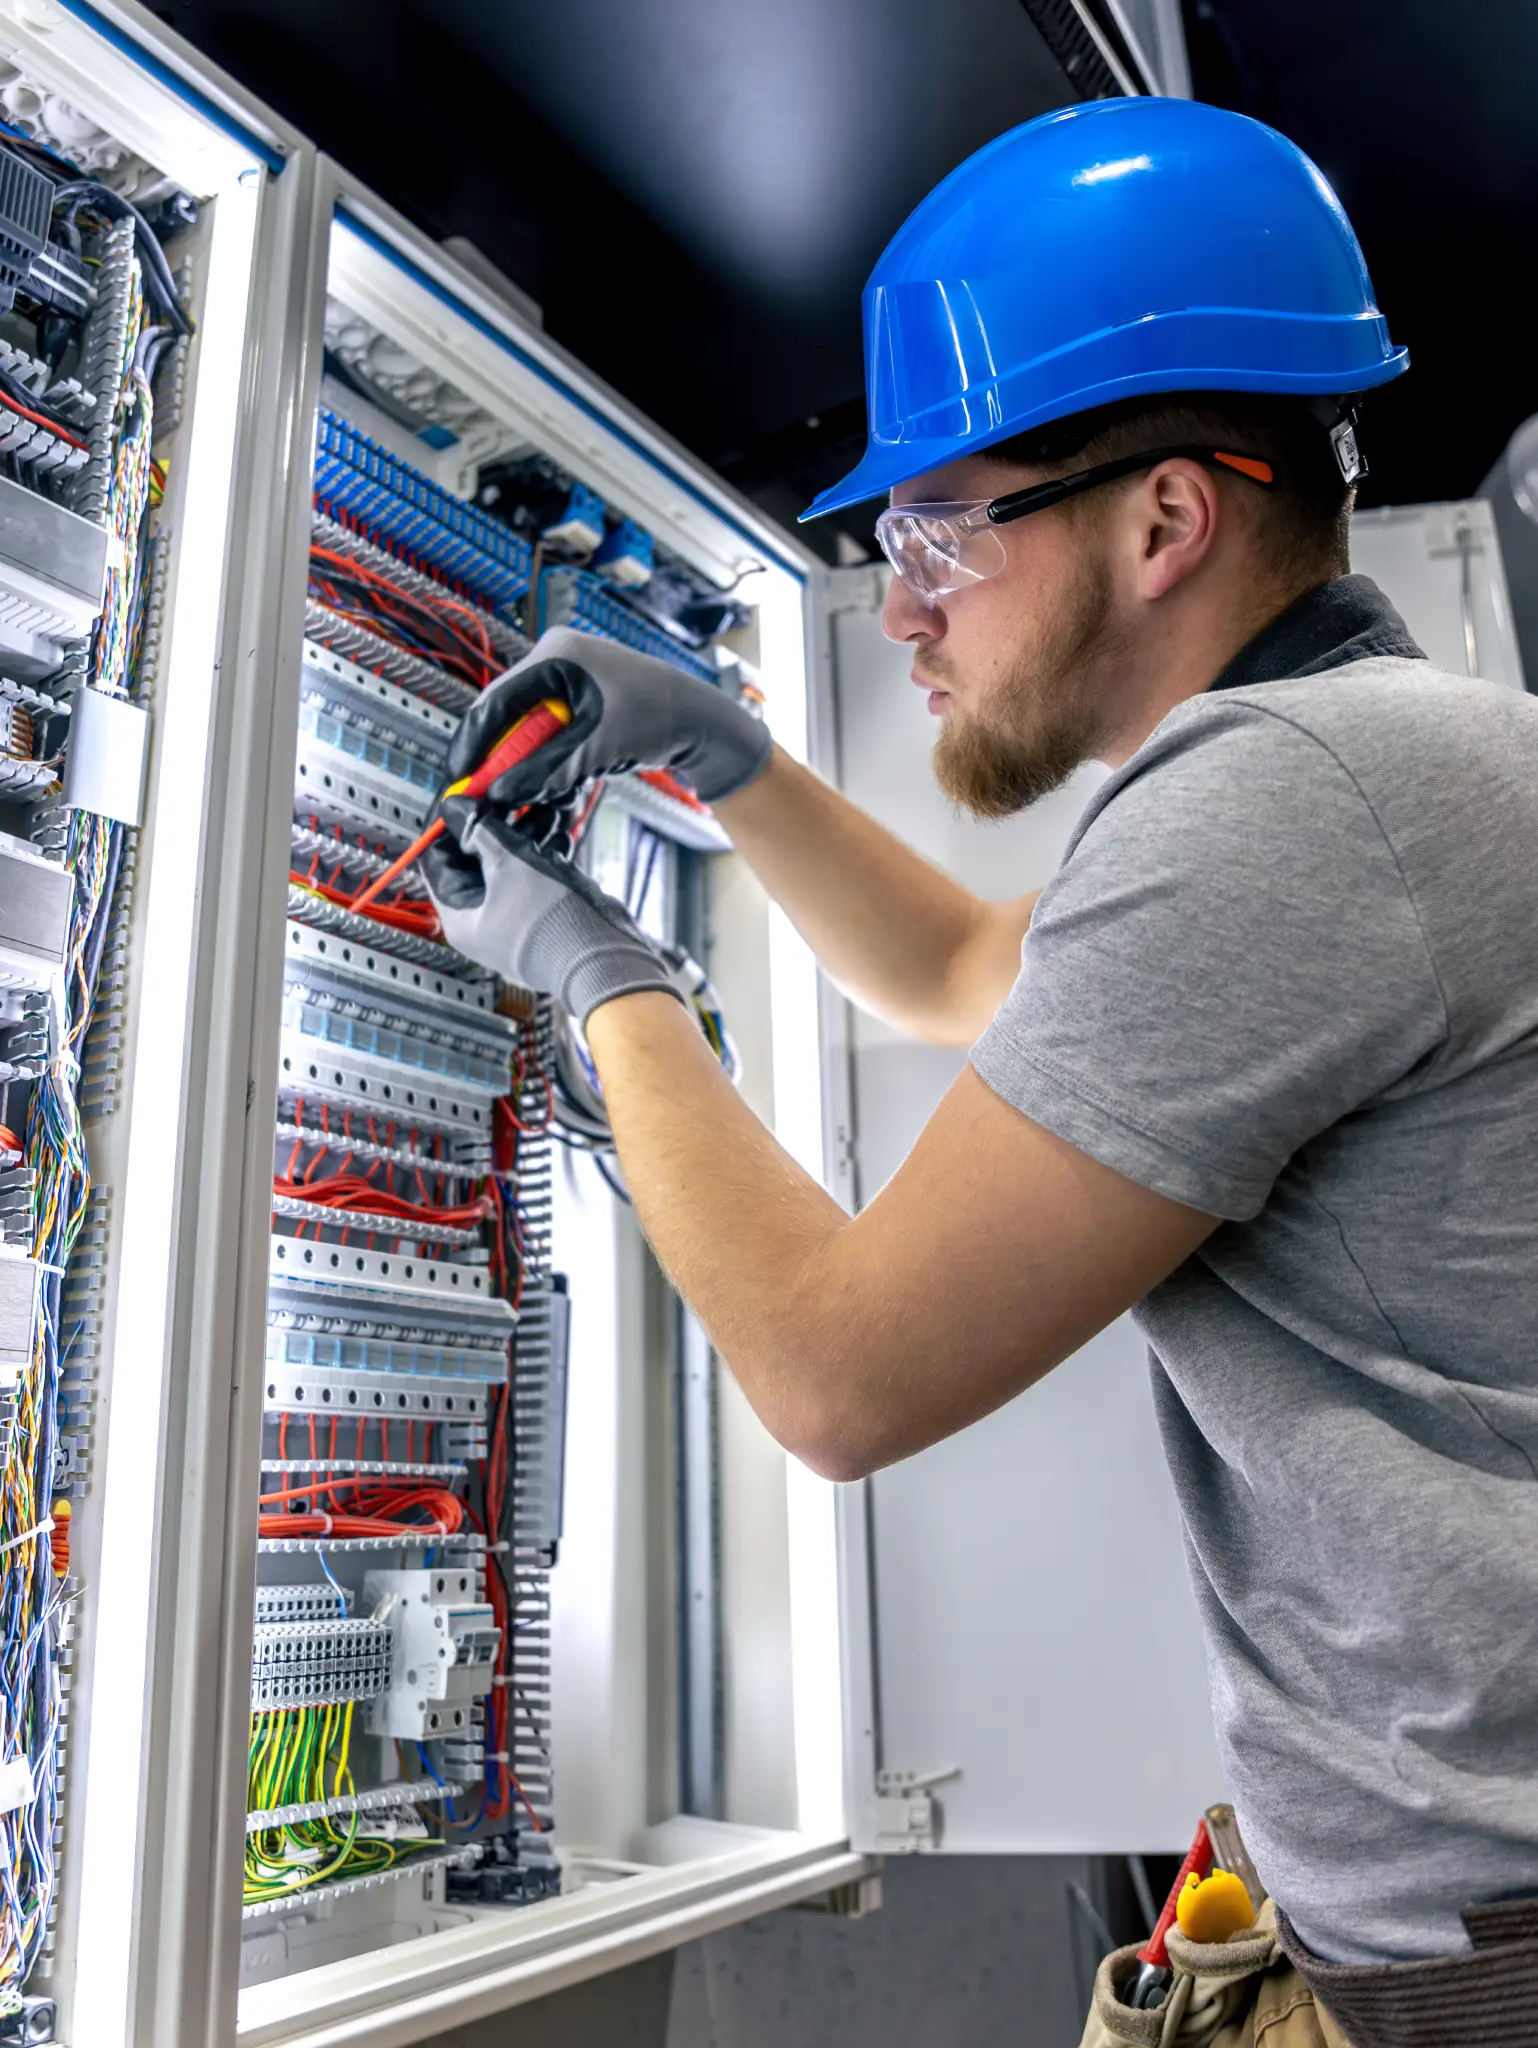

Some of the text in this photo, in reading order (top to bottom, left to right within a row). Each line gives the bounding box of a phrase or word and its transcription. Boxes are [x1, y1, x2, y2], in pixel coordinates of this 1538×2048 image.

[252, 1666, 258, 1675] 2
[265, 1666, 271, 1676] 3
[276, 1665, 282, 1673] 4
[286, 1664, 293, 1673] 5
[296, 1663, 301, 1672] 6
[316, 1662, 322, 1670] 8
[326, 1661, 332, 1669] 9
[355, 1659, 363, 1667] 12
